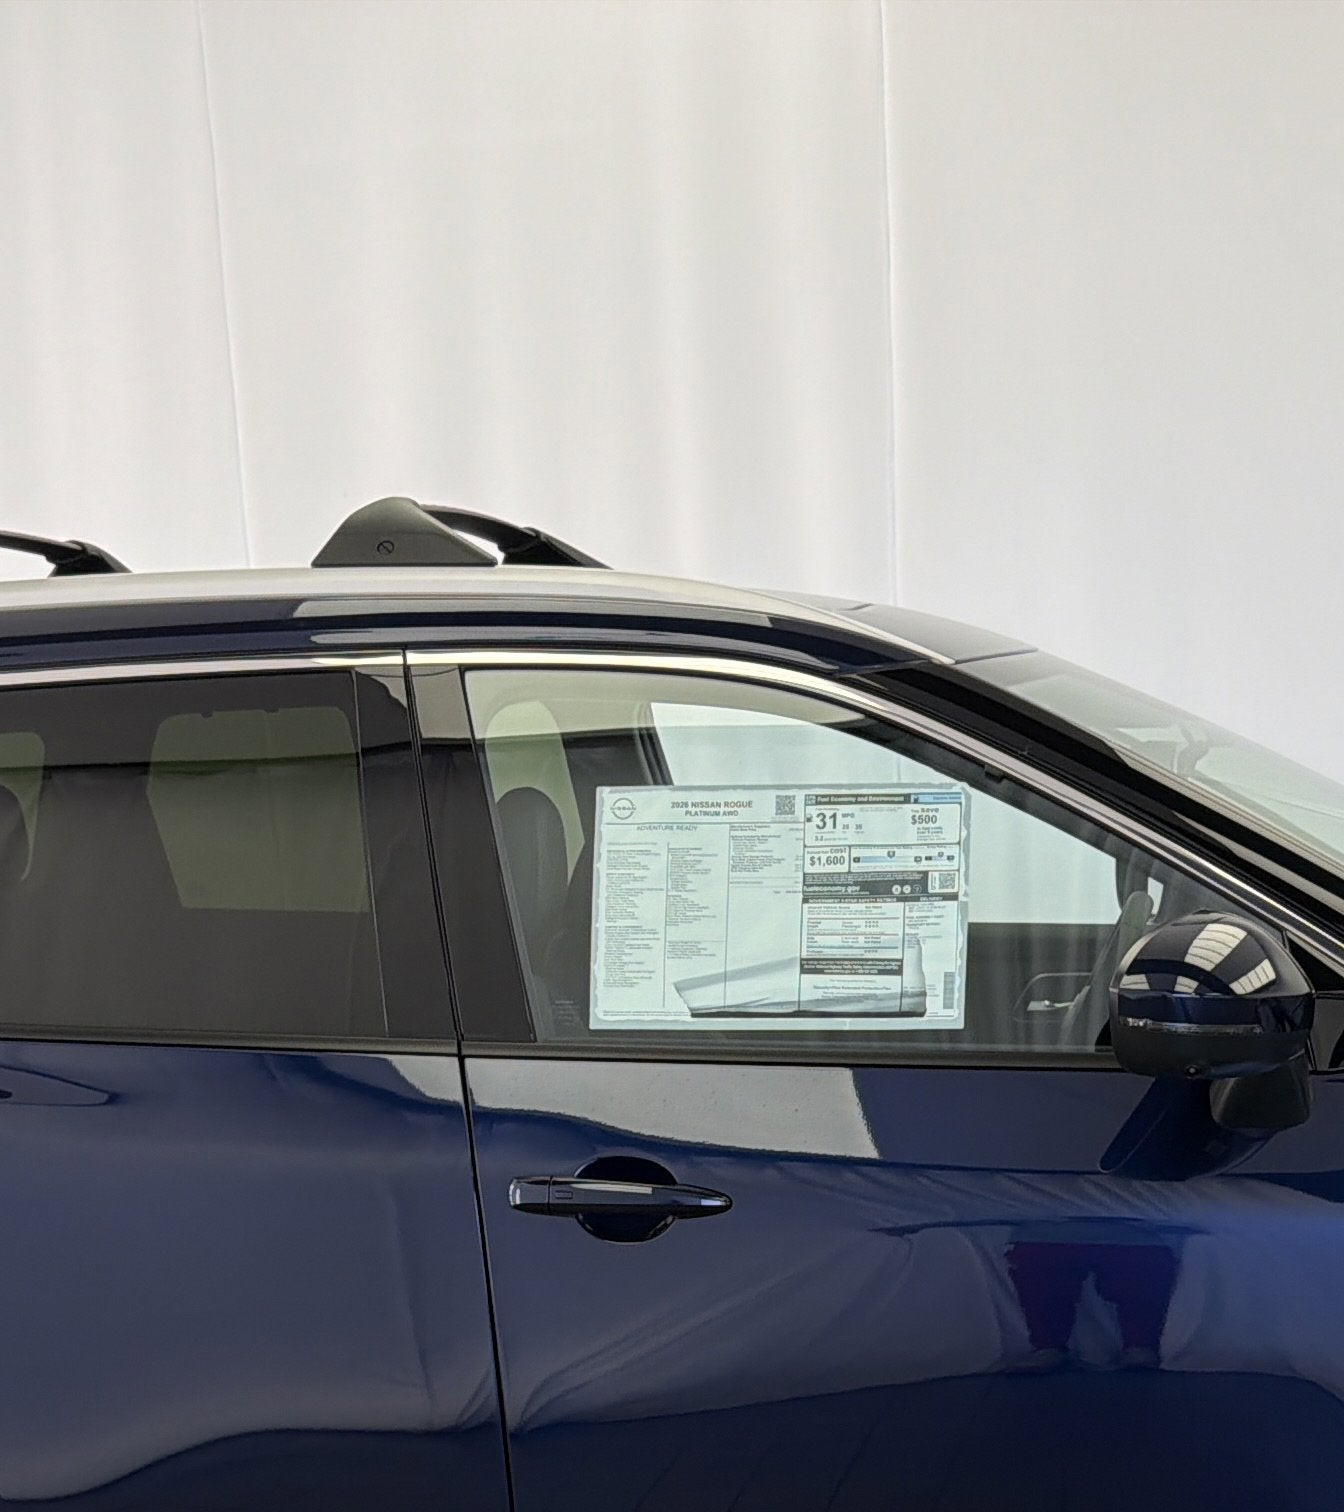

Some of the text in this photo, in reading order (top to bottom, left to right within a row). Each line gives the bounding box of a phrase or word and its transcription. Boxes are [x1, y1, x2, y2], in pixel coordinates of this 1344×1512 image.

[816, 812, 837, 830] 31
[911, 814, 938, 825] $500
[809, 856, 845, 867] $1,600
